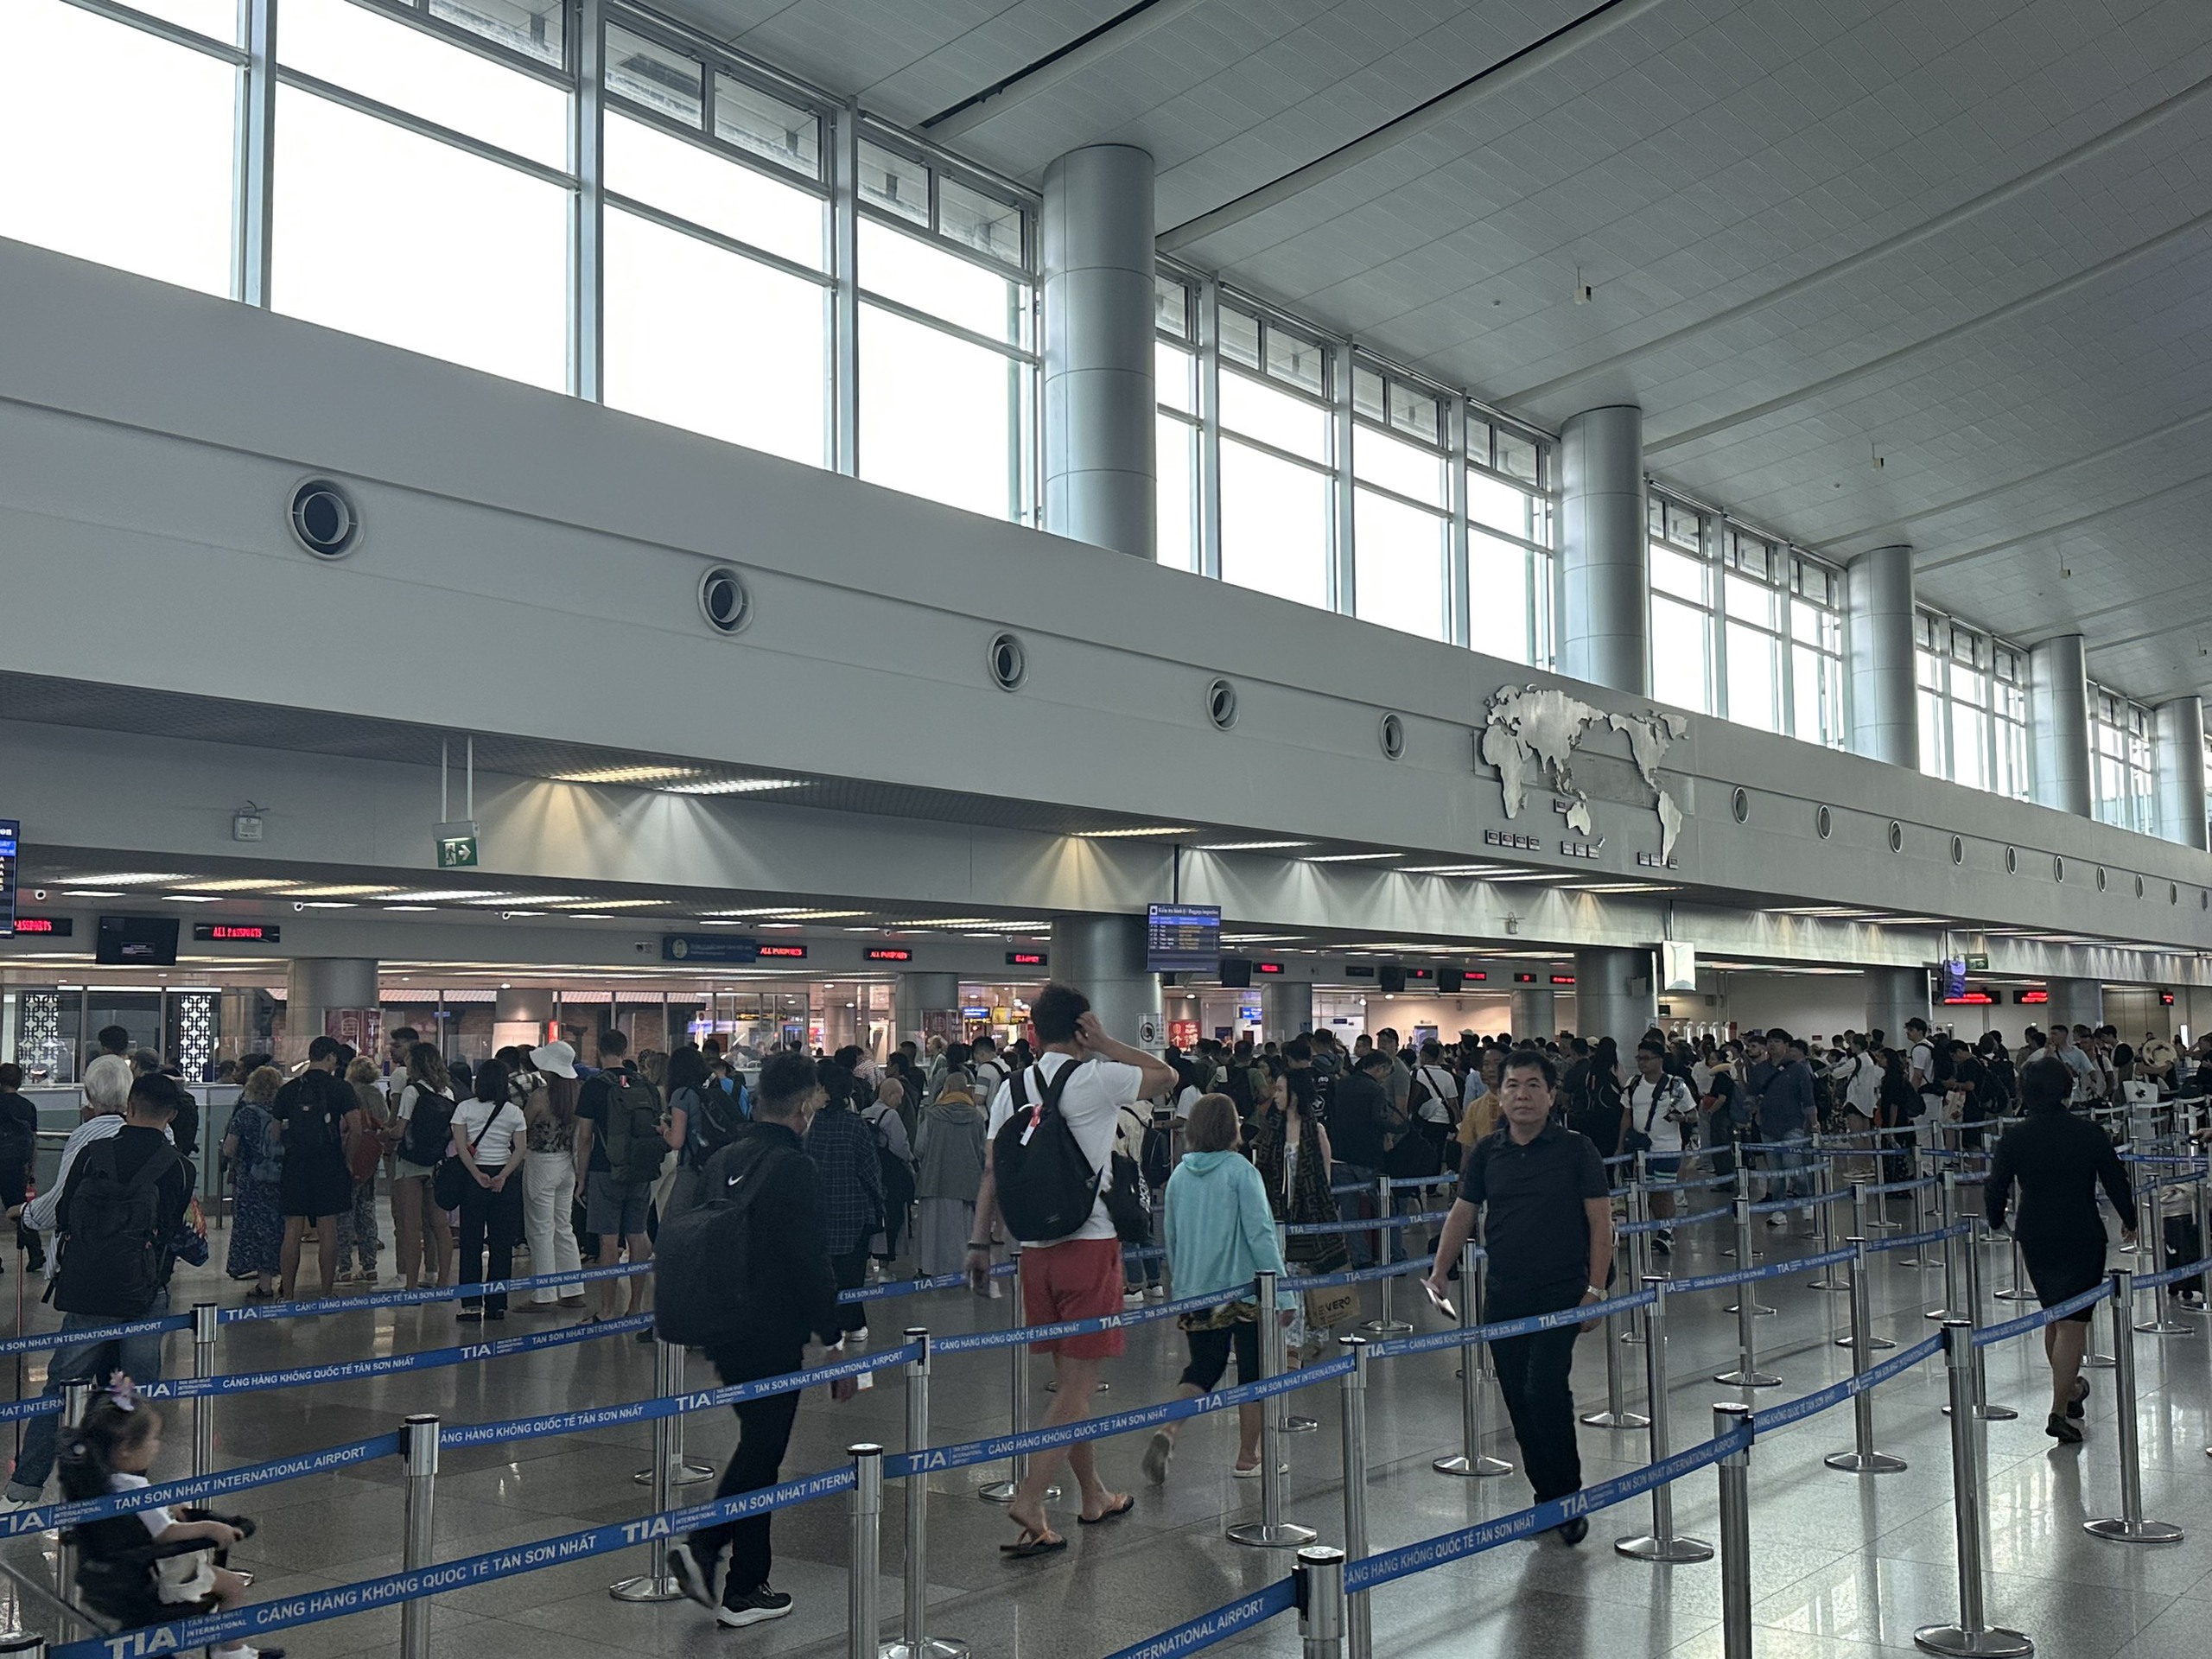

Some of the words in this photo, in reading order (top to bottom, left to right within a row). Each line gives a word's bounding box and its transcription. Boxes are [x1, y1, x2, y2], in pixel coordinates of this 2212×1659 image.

[213, 927, 226, 937] ALL
[912, 1279, 934, 1292] TIA
[1344, 1272, 1362, 1283] TIA
[480, 1281, 506, 1294] TIA
[226, 1307, 258, 1321] TIA
[1099, 1315, 1122, 1330] TIA
[1538, 1314, 1558, 1328] TIA
[6, 1342, 26, 1351] SON
[29, 1338, 52, 1348] NHAT
[54, 1328, 123, 1344] INTERNATIONAL
[124, 1321, 162, 1334] AIRPORT
[461, 1345, 492, 1359] TIA
[753, 1382, 771, 1394] TAN
[771, 1380, 789, 1391] SON
[789, 1374, 811, 1388] NHAT
[811, 1361, 871, 1382] INTERNATIONAL
[871, 1351, 904, 1368] AIRPORT
[134, 1384, 171, 1398] TIA
[675, 1393, 711, 1411] TIA
[1194, 1395, 1223, 1412] TIA
[0, 1405, 20, 1418] HAT
[439, 1430, 463, 1444] ẢNG
[909, 1452, 947, 1471] TIA
[114, 1495, 141, 1510] TAN
[144, 1489, 172, 1504] SON
[175, 1481, 211, 1498] NHAT
[213, 1459, 312, 1491] INTERNATIONAL
[314, 1446, 366, 1468] AIRPORT
[724, 1501, 747, 1516] TAN
[749, 1493, 774, 1510] SON
[776, 1484, 806, 1503] NHAT
[810, 1471, 856, 1493] INTERNA
[1560, 1494, 1589, 1517] TIA
[621, 1516, 671, 1543] TIA
[310, 1591, 357, 1614] HÀNG
[559, 1534, 596, 1556] NHẤT
[1217, 1598, 1265, 1630] AIRPORT
[187, 1619, 248, 1638] INTERNATIONAL
[105, 1627, 178, 1659] TIA
